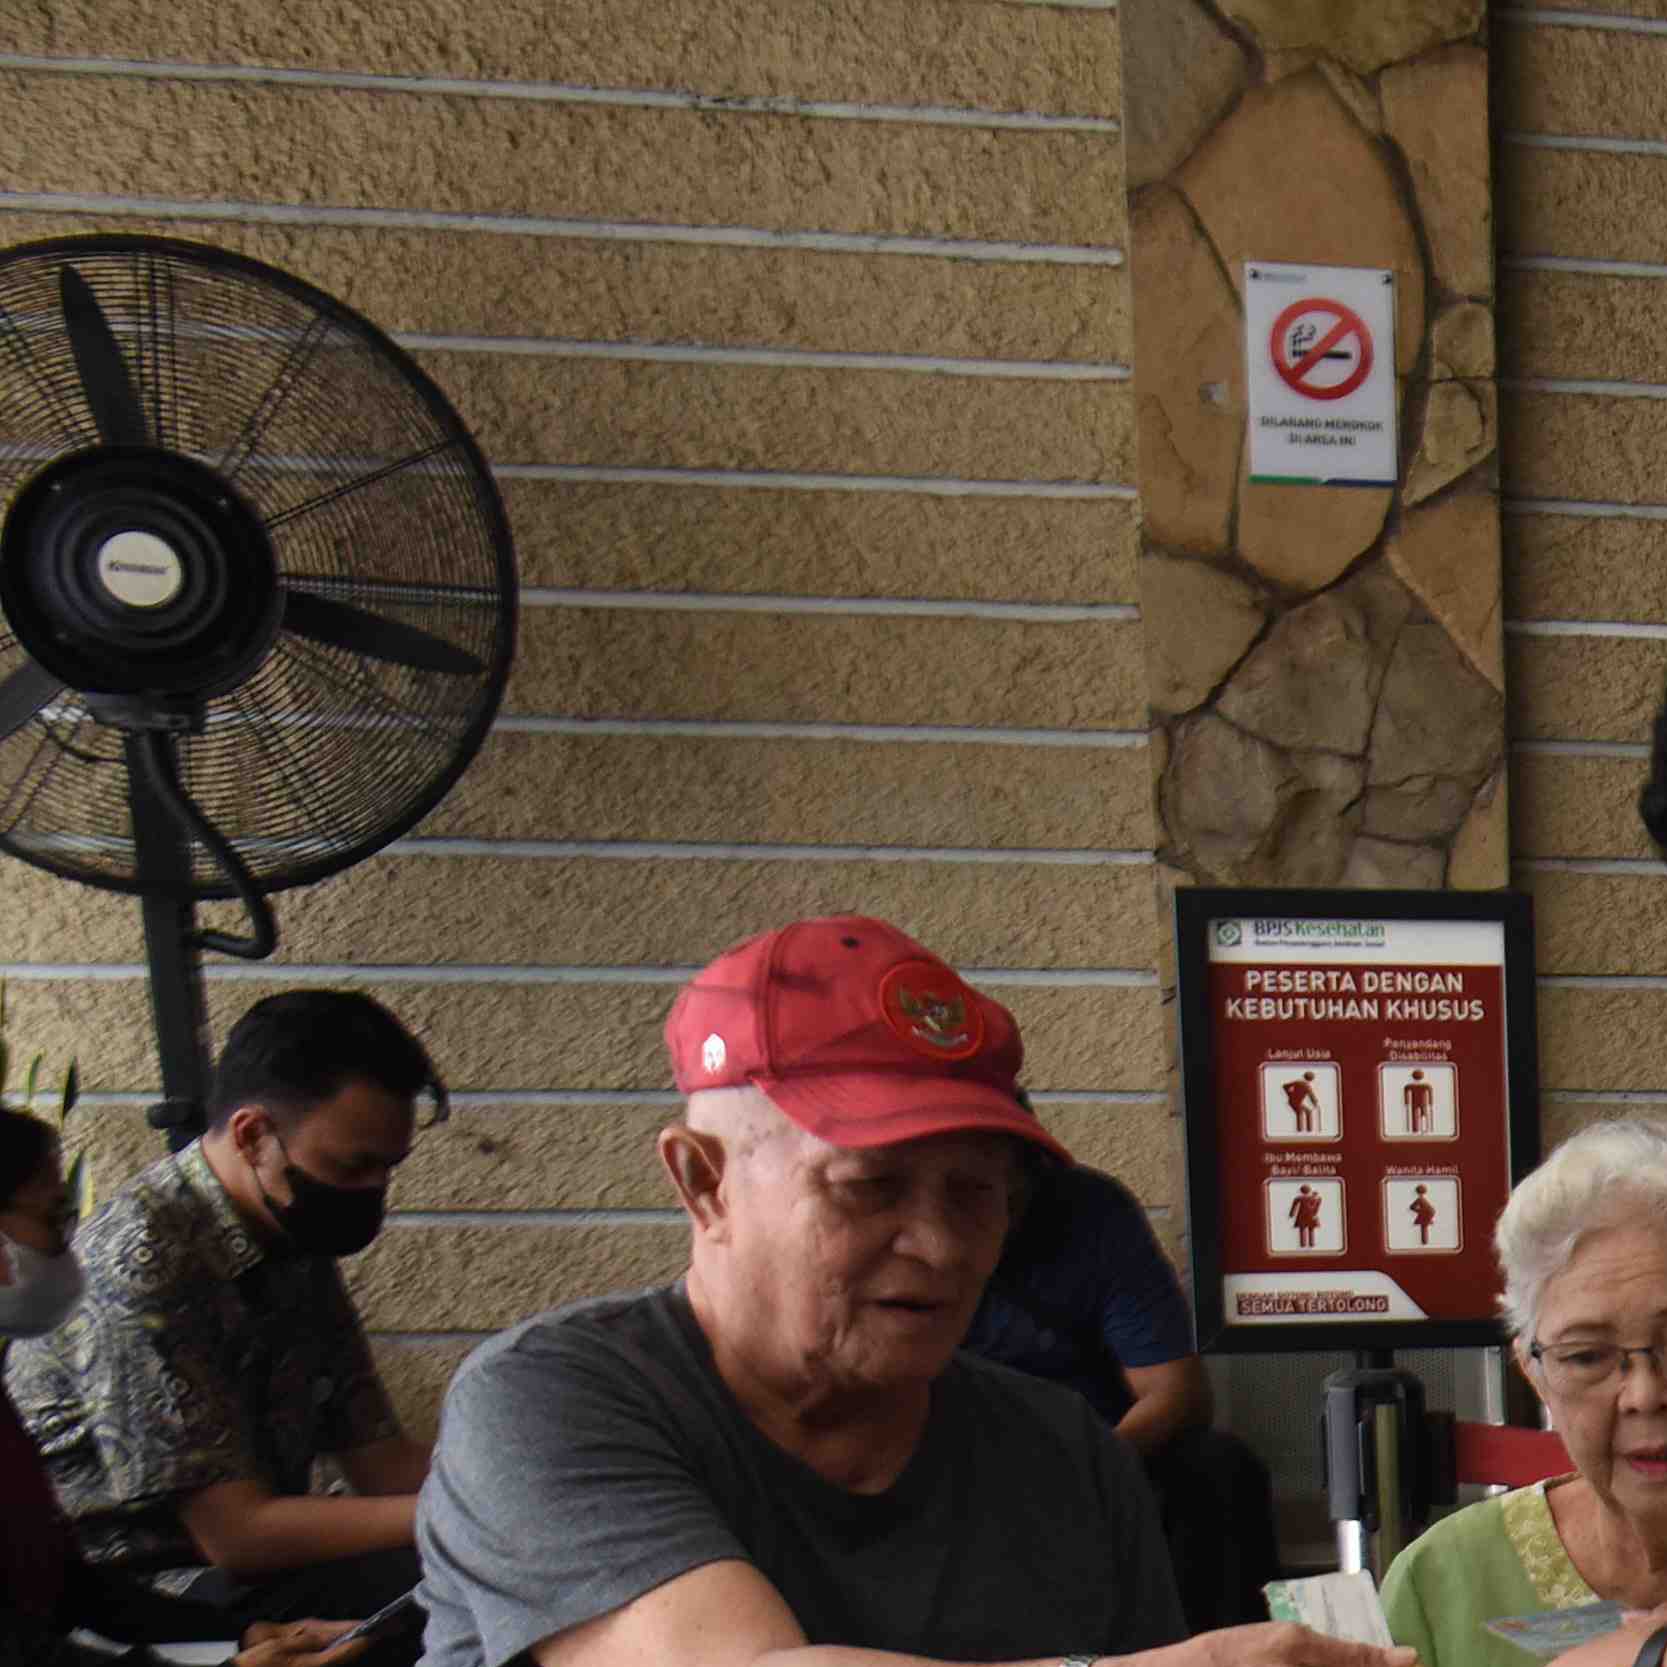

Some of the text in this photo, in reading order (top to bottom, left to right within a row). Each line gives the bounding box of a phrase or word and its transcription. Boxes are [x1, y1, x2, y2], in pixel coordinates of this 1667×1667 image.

[1246, 970, 1464, 993] PESERTA DENGAN
[1225, 997, 1485, 1021] KEBUTUHAN KHUSUS
[1241, 1296, 1387, 1313] SEMUA TERTOLONG
